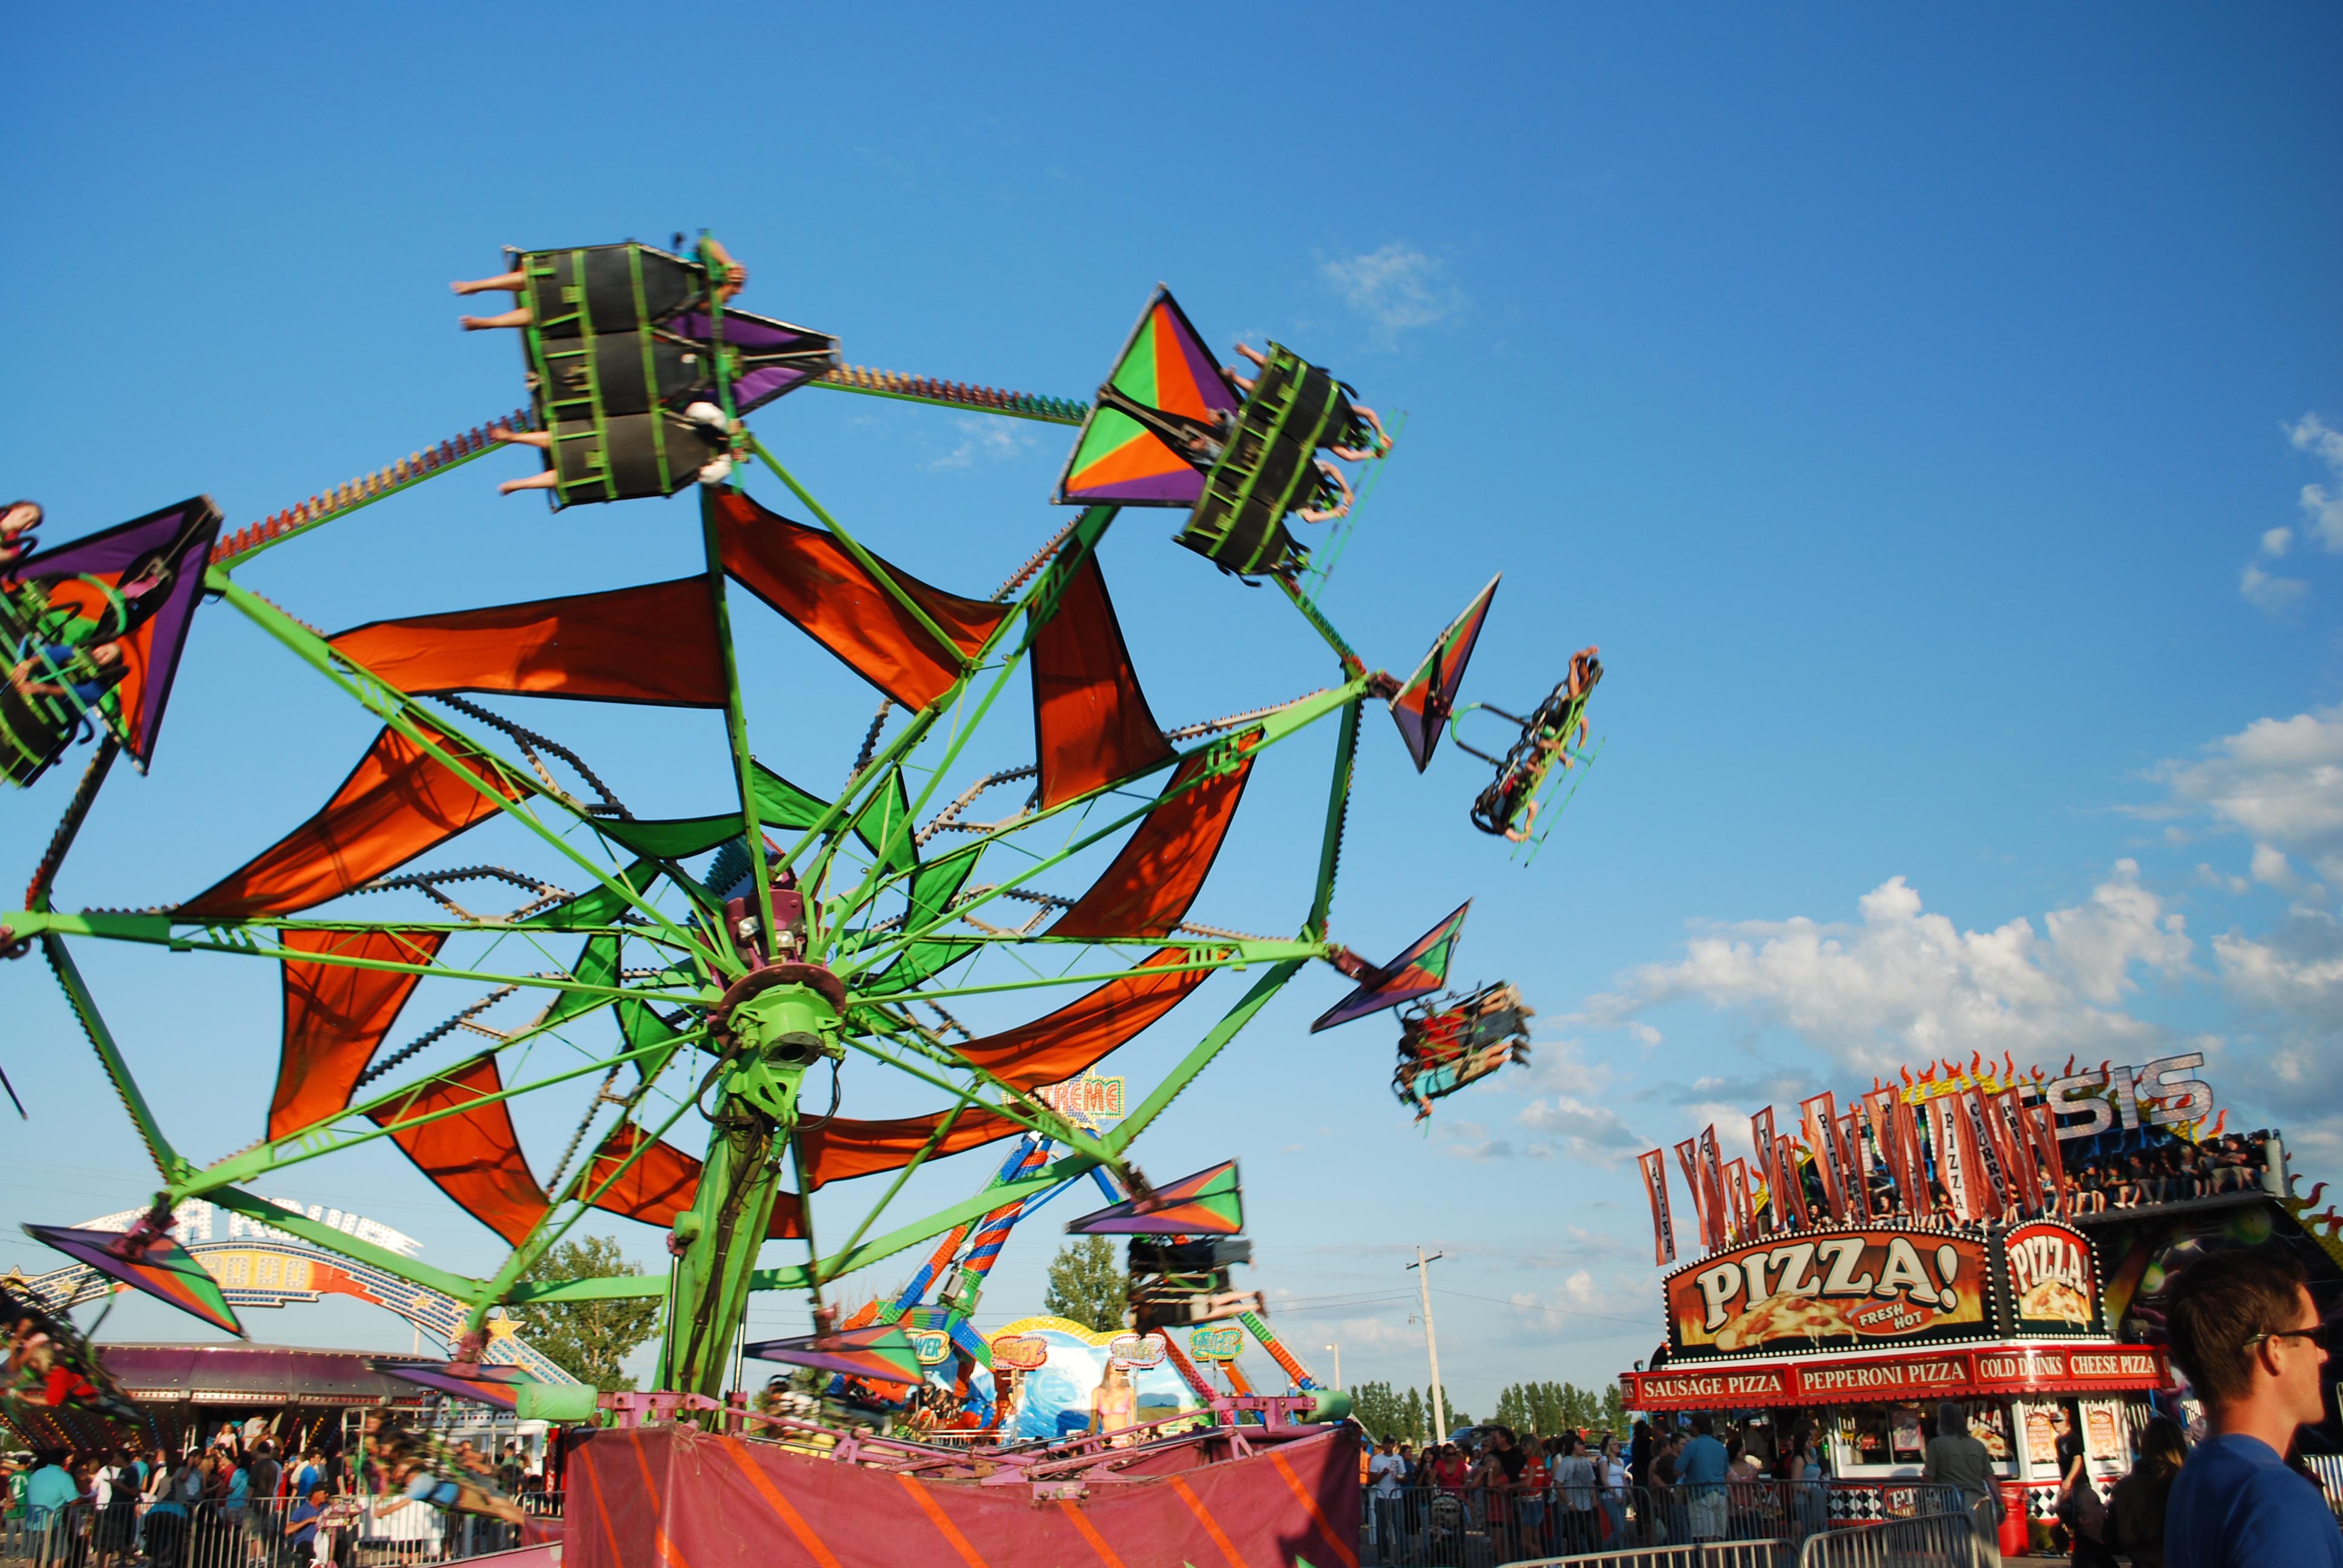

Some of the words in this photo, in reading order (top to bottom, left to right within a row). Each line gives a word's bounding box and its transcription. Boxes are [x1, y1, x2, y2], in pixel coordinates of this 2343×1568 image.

[1010, 1082, 1118, 1112] TREME
[1944, 1112, 1964, 1209] PIZZA
[2008, 1235, 2088, 1296] PIZZA!
[1696, 1236, 1959, 1331] PIZZA!
[1858, 1302, 1904, 1327] FRESH
[1893, 1310, 1922, 1330] HOT
[912, 1338, 942, 1357] WER
[1803, 1366, 1904, 1390] PEPPERONI
[1907, 1361, 1966, 1383] PIZZA
[1980, 1357, 2016, 1378] COLD
[2018, 1356, 2063, 1376] DRINKS
[2070, 1355, 2119, 1374] CHEESE
[2120, 1355, 2157, 1374] PIZZA
[1644, 1377, 1724, 1398] SAUSAGE
[1728, 1374, 1782, 1394] PIZZA
